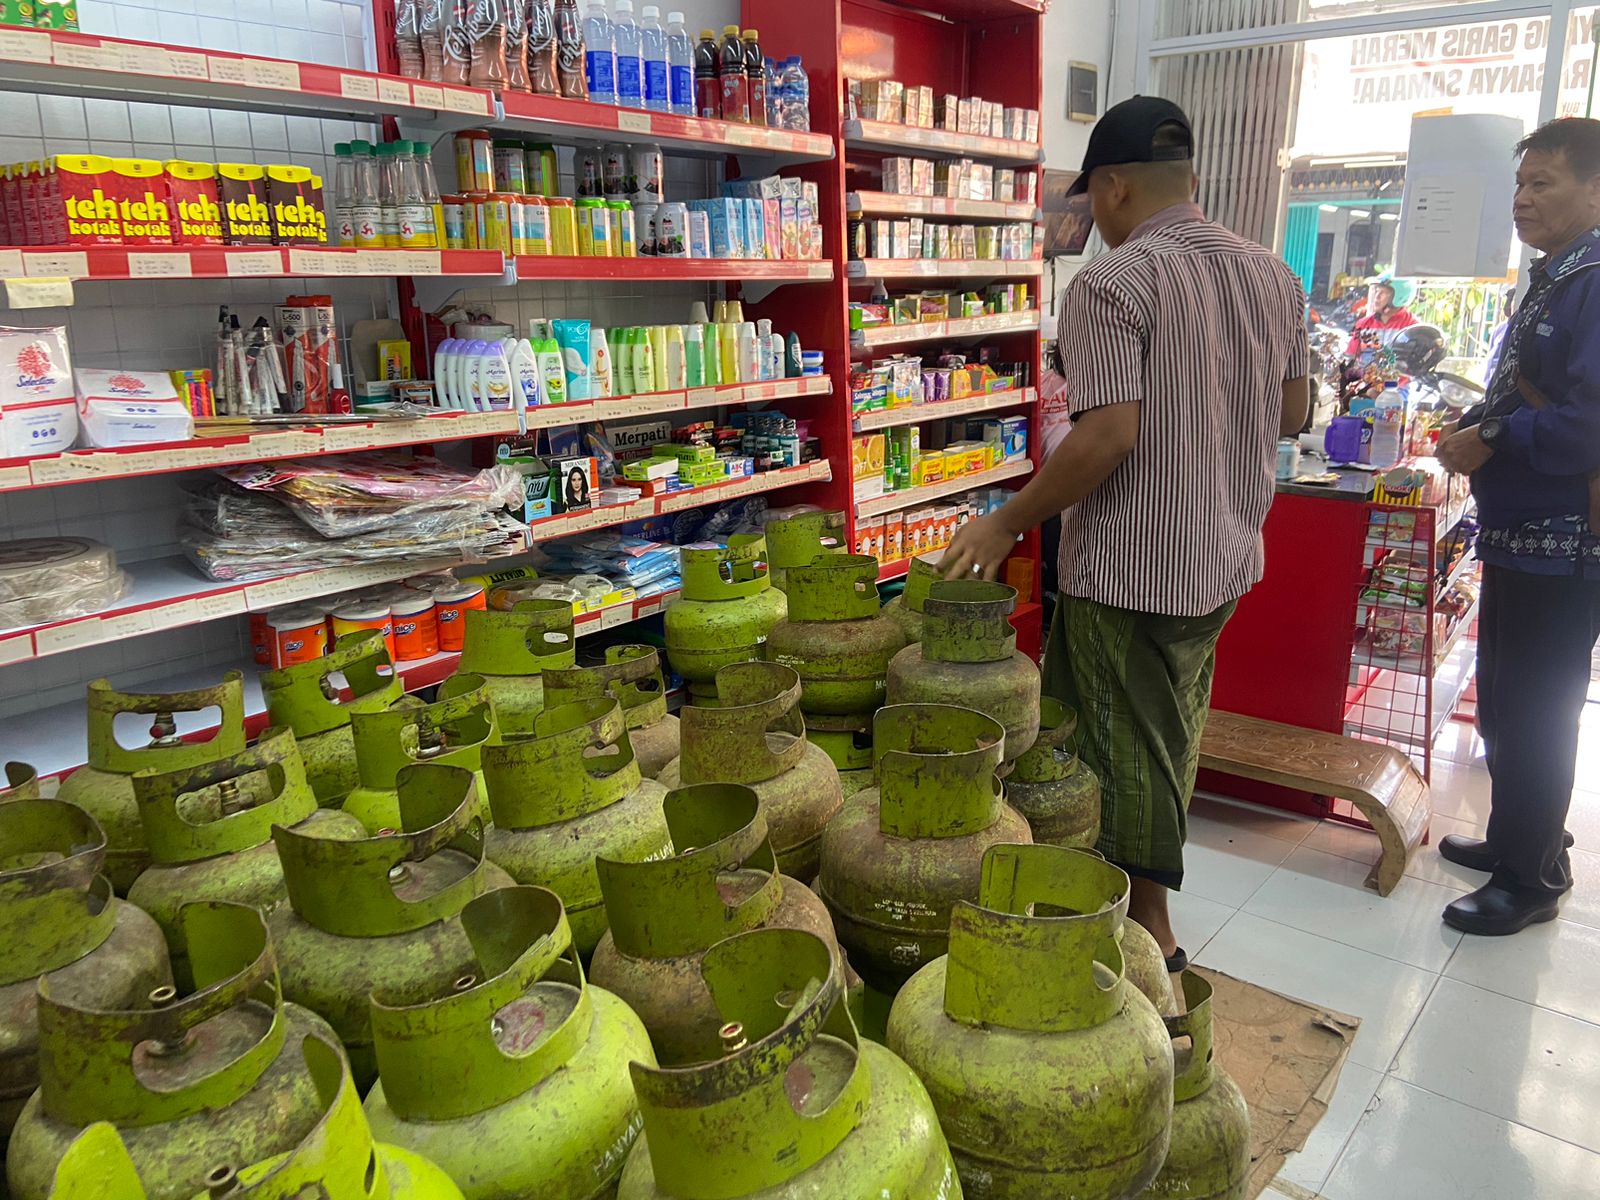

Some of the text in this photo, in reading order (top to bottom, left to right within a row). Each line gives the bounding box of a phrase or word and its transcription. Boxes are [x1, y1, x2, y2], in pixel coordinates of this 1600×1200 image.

[65, 188, 118, 219] teh
[120, 191, 169, 221] teh
[177, 193, 220, 221] teh
[226, 193, 269, 221] teh
[274, 195, 317, 223] teh
[69, 219, 120, 235] kotak
[123, 221, 171, 236] kotak
[181, 221, 222, 236] kotak
[229, 221, 271, 236] kotak
[277, 222, 318, 237] kotak
[16, 375, 56, 387] Selection
[614, 425, 667, 447] Merpati
[440, 610, 459, 622] nice
[395, 623, 416, 636] nice
